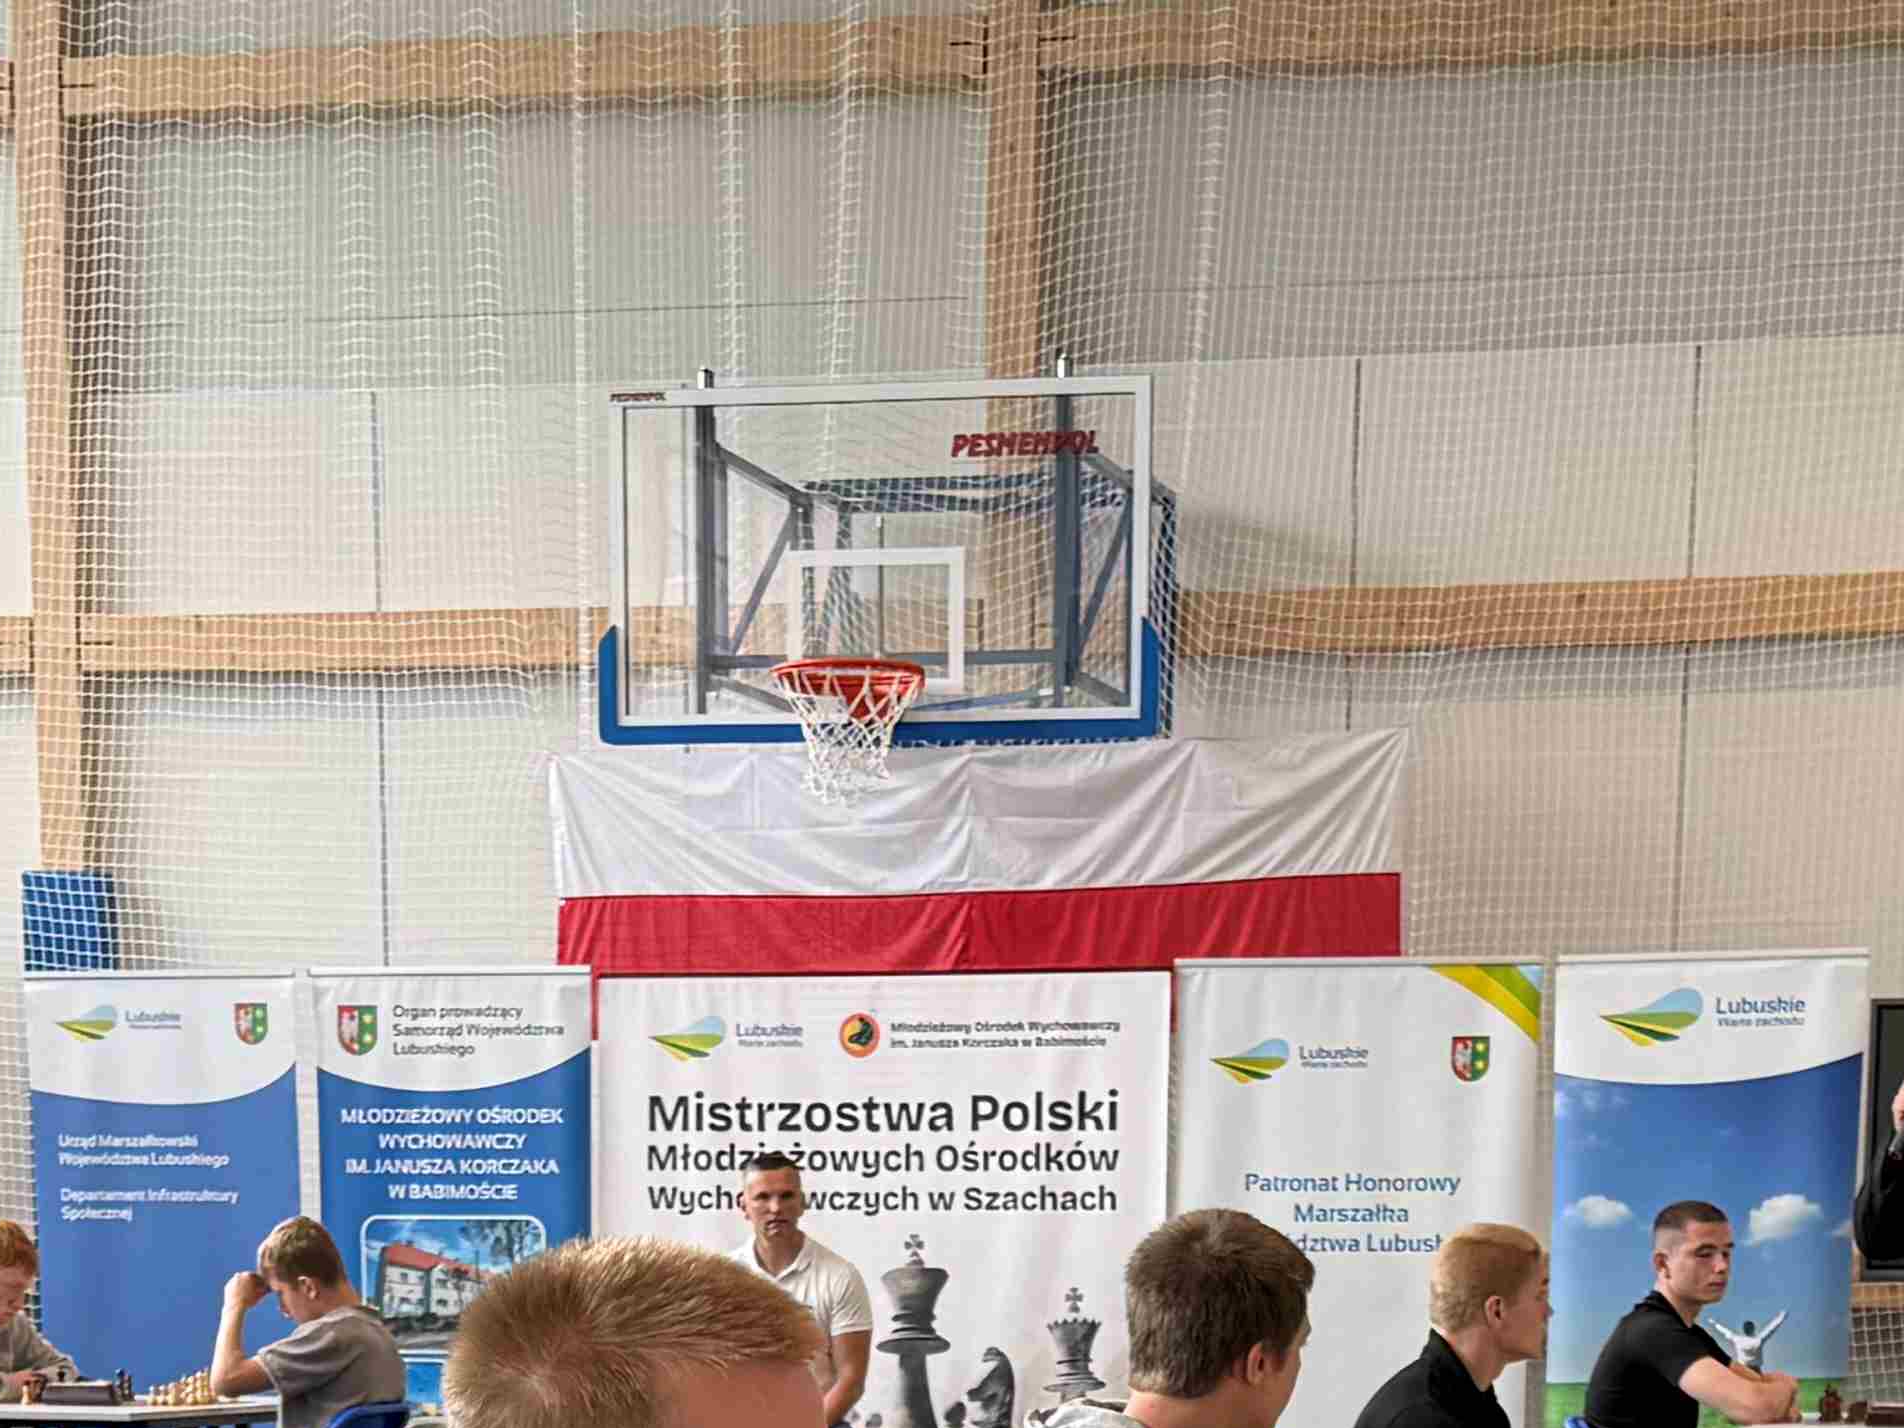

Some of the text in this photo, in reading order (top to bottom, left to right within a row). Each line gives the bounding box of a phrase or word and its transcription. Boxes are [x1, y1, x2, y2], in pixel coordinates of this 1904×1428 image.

[392, 1004, 523, 1020] Organ prowadzący
[1715, 996, 1805, 1014] Lubuskie
[392, 1023, 463, 1039] Samorząd
[392, 1042, 476, 1057] Lubuskiego
[341, 1105, 564, 1124] MŁODZIEŻOWY OŚRODEK
[648, 1089, 1120, 1133] Mistrzostwa Polski
[378, 1133, 527, 1150] WYCHOWAWCZY
[373, 1159, 457, 1175] JANUSZA
[460, 1159, 560, 1175] KORCZAKA
[646, 1141, 1120, 1178] Młodzżowych Ośrodków
[388, 1182, 518, 1200] W BABIMOŚCIE
[1244, 1172, 1461, 1196] Patronat Honorowy
[647, 1185, 1118, 1214] Wychwczych w Szachach
[1293, 1203, 1410, 1223] Marszałka
